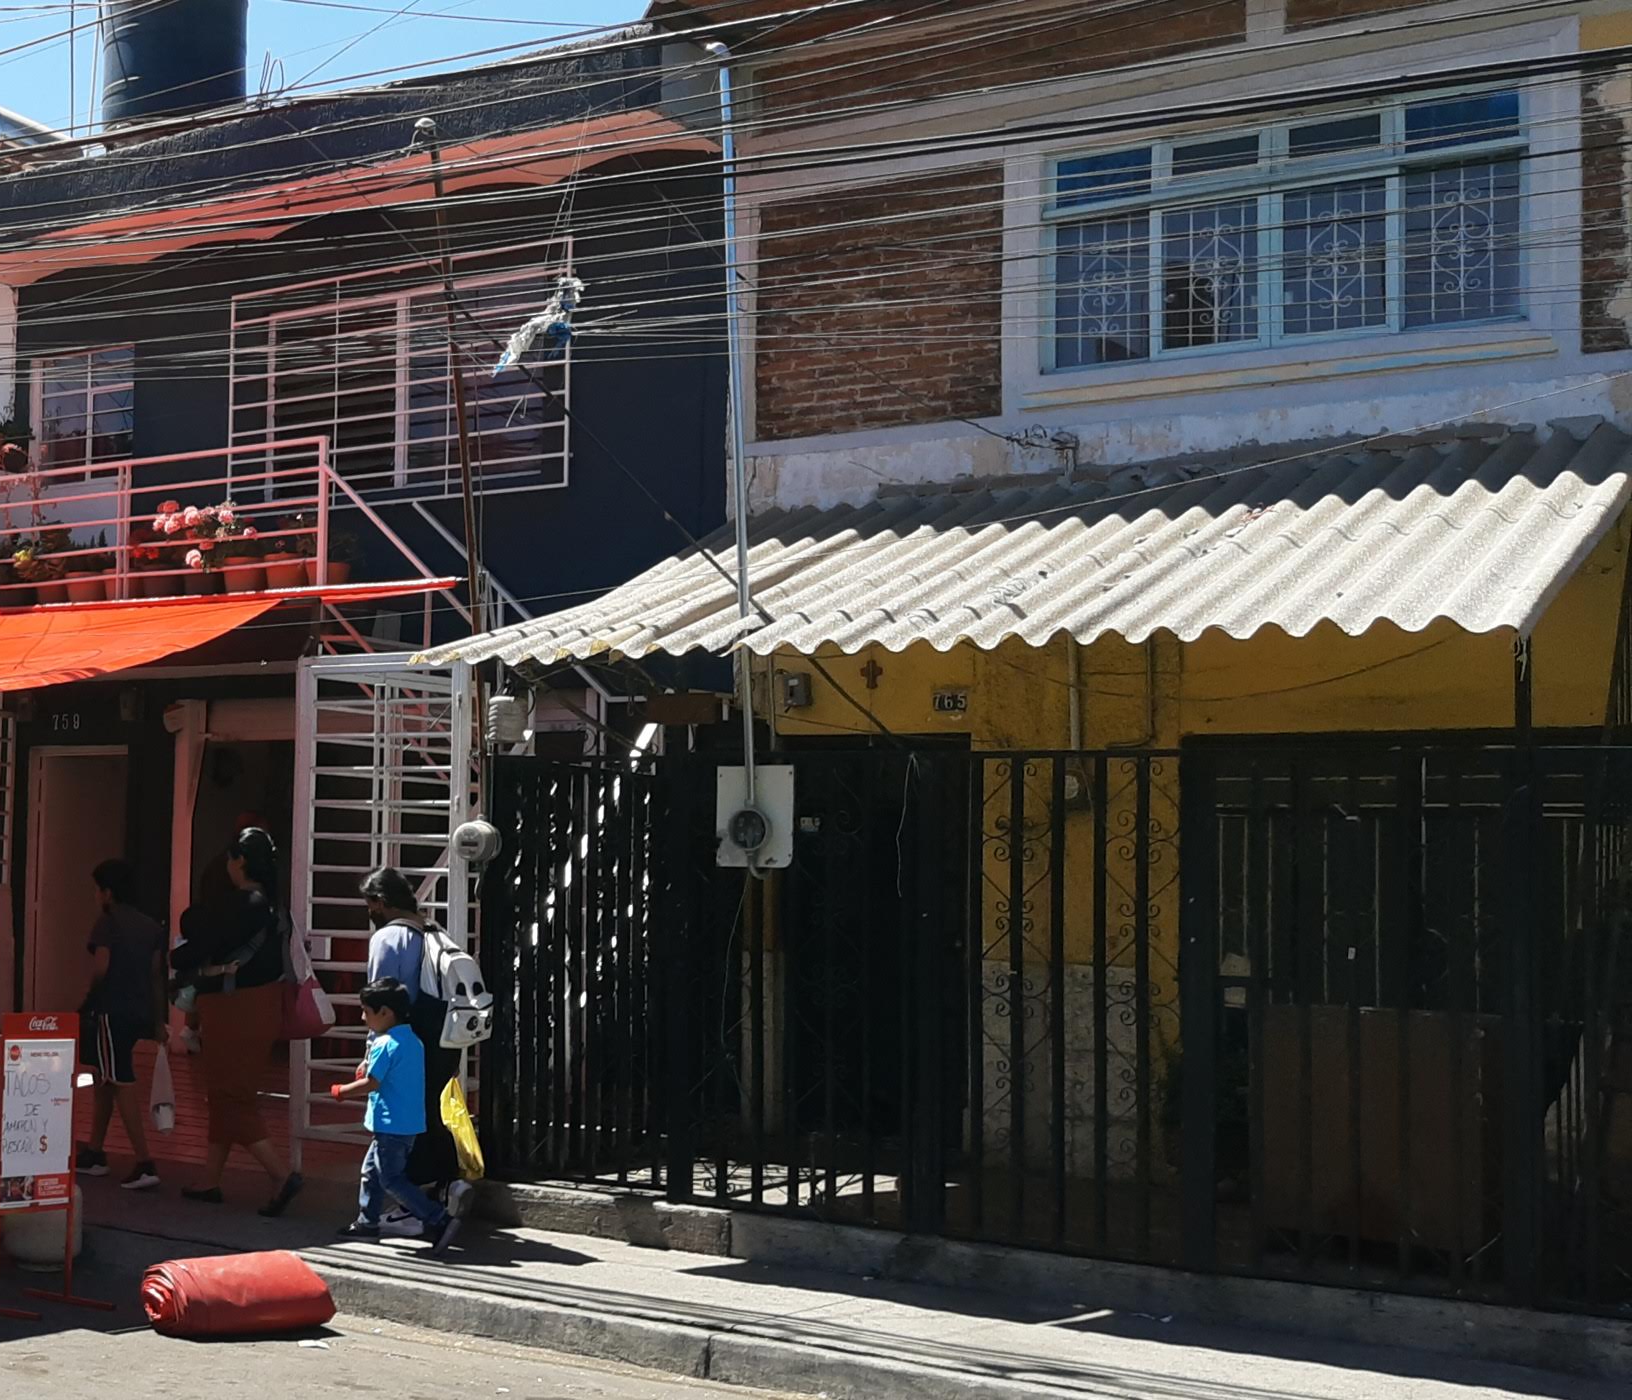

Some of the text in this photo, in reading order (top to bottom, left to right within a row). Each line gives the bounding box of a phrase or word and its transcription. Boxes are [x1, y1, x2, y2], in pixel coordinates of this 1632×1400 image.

[932, 692, 966, 711] 765
[52, 713, 80, 731] 759
[6, 1070, 51, 1098] TACOS
[24, 1103, 41, 1117] DE
